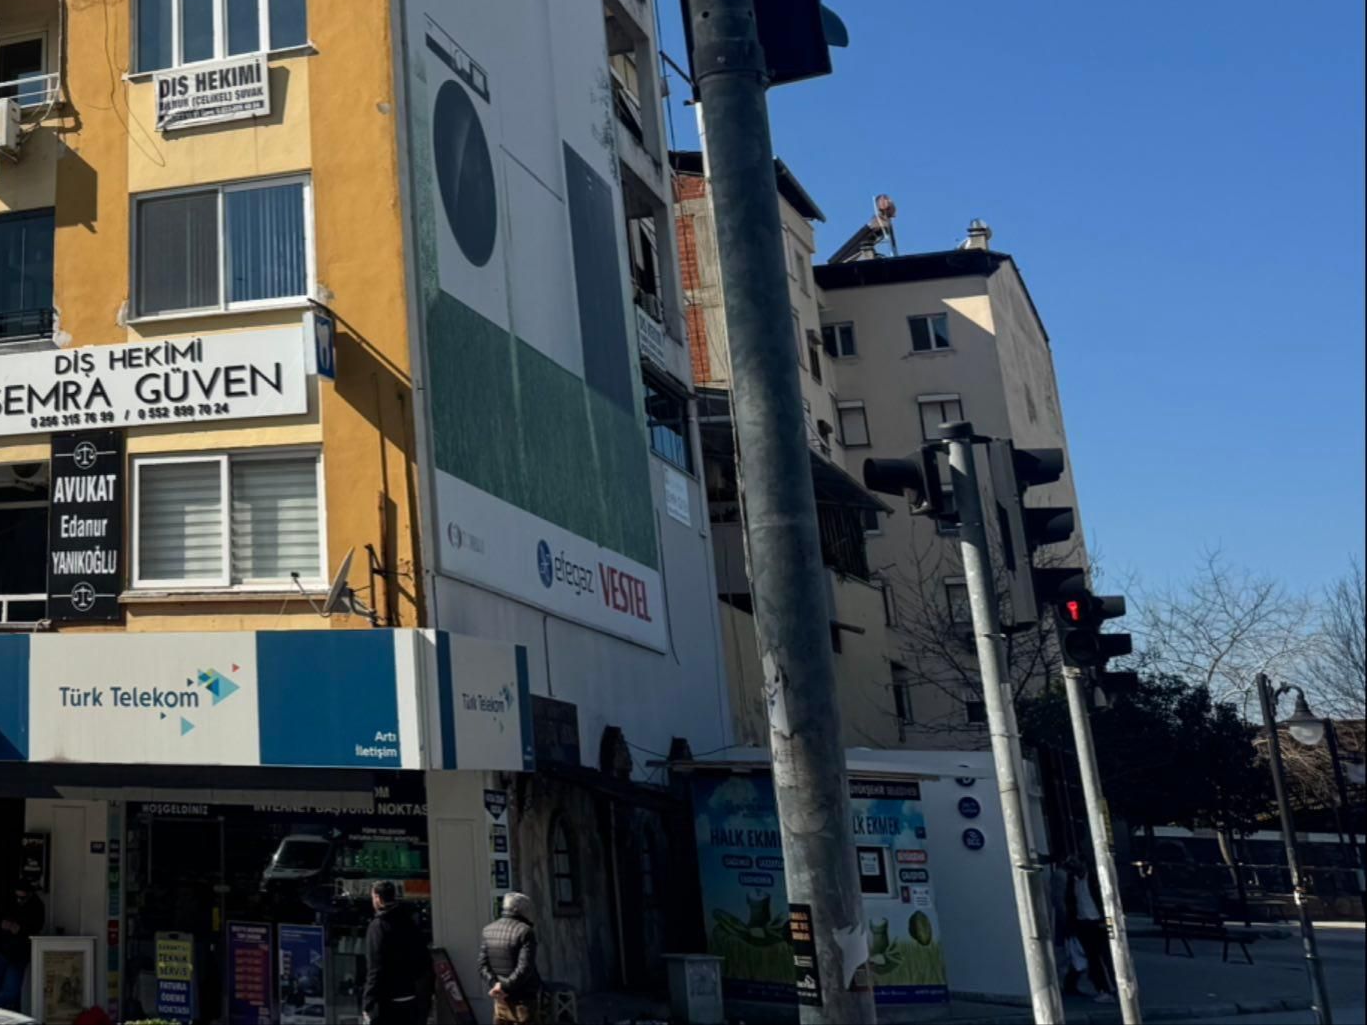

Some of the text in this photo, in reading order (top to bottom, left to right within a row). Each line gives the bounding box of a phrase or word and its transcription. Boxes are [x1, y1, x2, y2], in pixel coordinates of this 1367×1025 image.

[54, 338, 204, 379] DİŞ HEKİMİ
[135, 362, 283, 404] GÜVEN
[62, 413, 82, 426] 315
[84, 412, 98, 424] 76
[148, 406, 170, 419] 552
[198, 403, 213, 416] 70
[214, 402, 230, 415] 24
[53, 475, 117, 503] AVUKAT
[61, 514, 108, 538] Edanur
[52, 545, 117, 575] YANIKOĞLU
[554, 550, 652, 623] efegaz VESTEL
[59, 687, 199, 707] Türk Telekom
[355, 743, 398, 759] İletişim
[377, 802, 429, 816] NOKTAS
[852, 815, 865, 835] LK
[710, 828, 782, 849] HALK EKM
